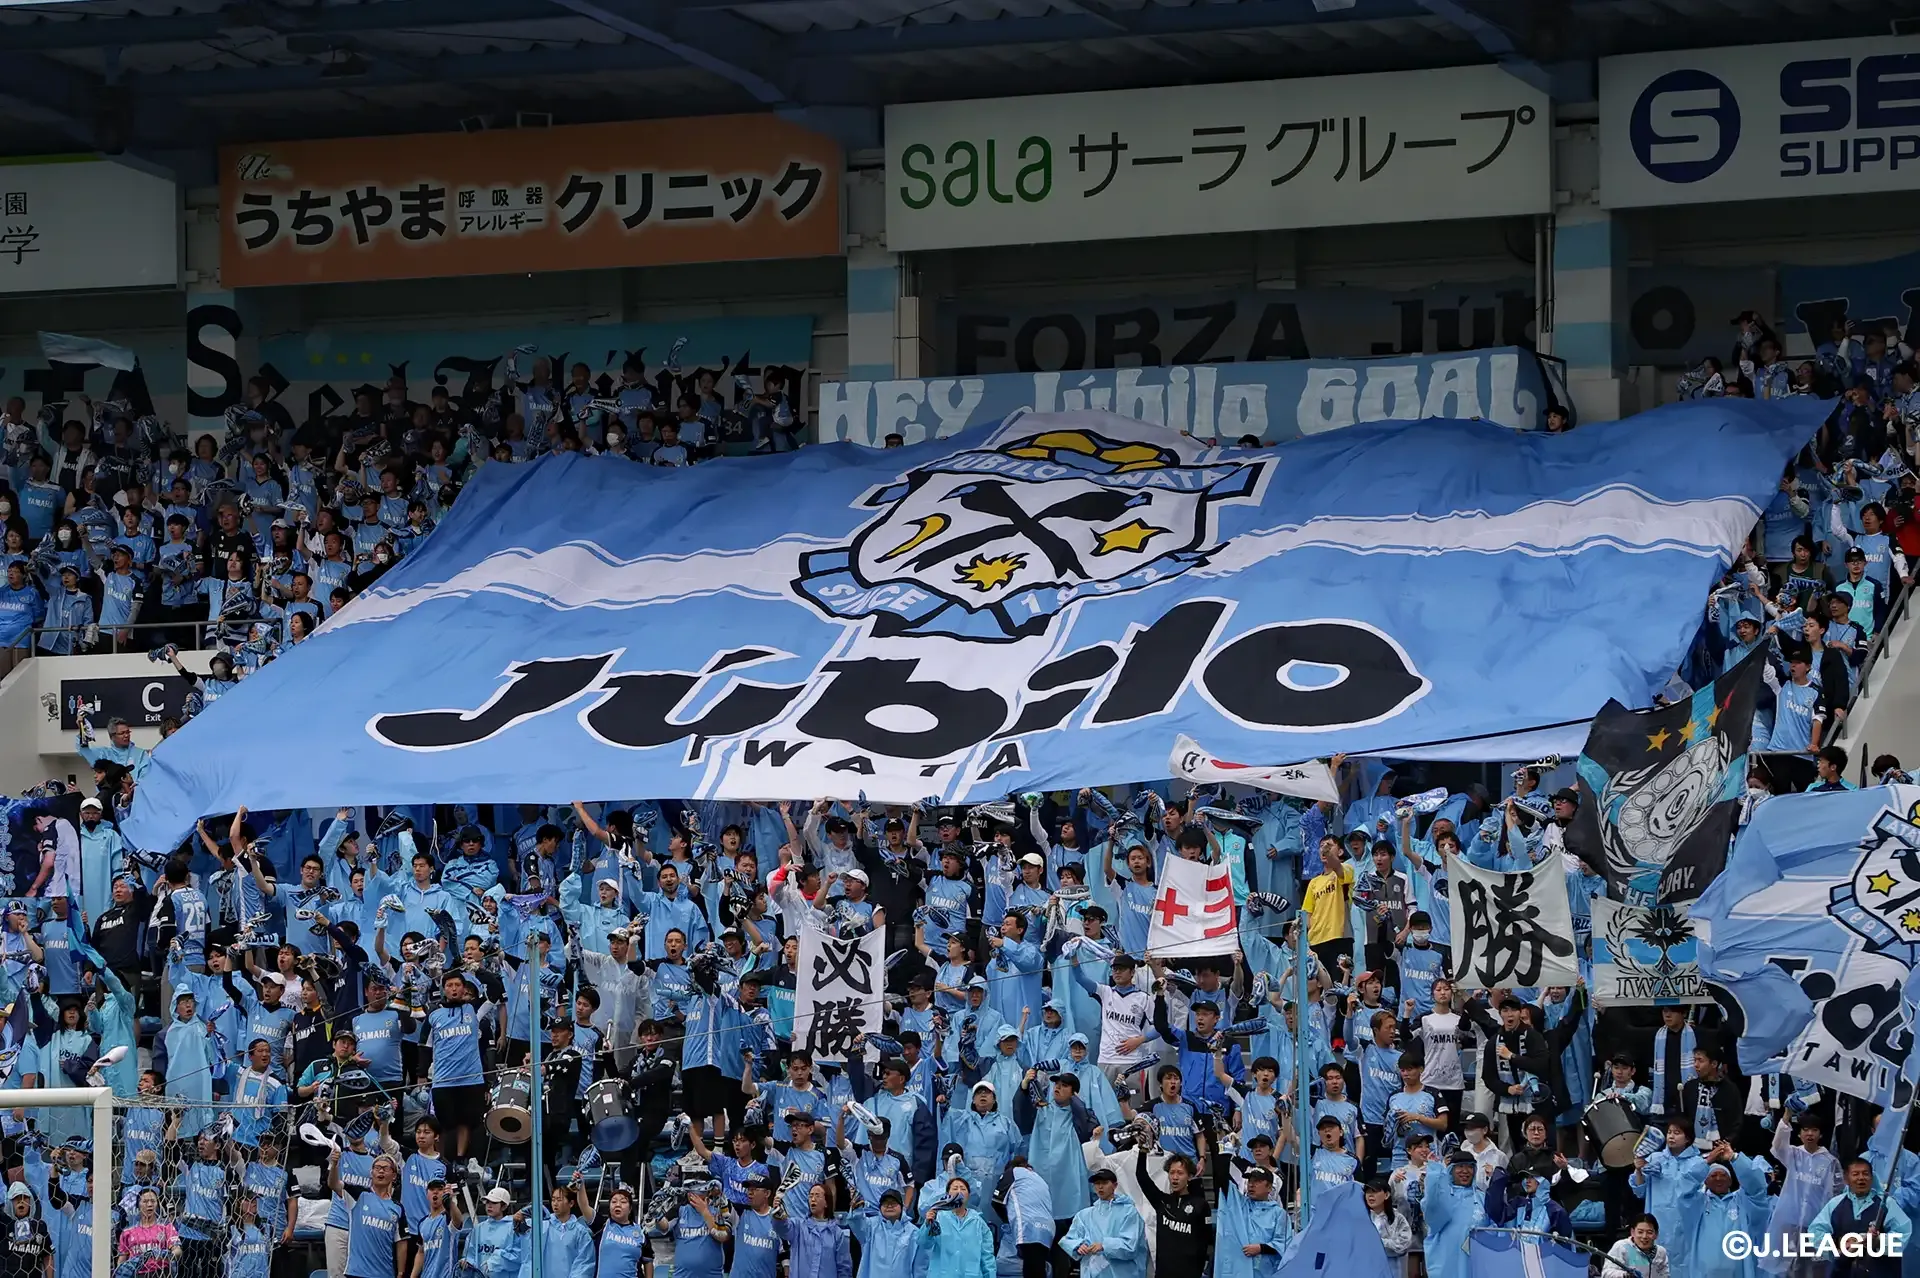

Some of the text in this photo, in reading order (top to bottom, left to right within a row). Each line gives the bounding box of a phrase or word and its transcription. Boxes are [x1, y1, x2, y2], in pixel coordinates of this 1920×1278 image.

[1069, 105, 1535, 198] サーラグループ
[555, 161, 822, 232] クリニック
[236, 184, 446, 249] うちやま
[459, 211, 543, 233] アレルギー
[957, 301, 1311, 374] FORZA
[819, 376, 985, 449] HEY
[1299, 352, 1537, 437] GOAL
[818, 582, 928, 614] SINCE
[370, 598, 1428, 758] Júbilo
[141, 682, 164, 712] C
[145, 714, 161, 722] Exit
[689, 735, 1024, 779] IWATA
[183, 903, 205, 932] 26
[1455, 872, 1574, 988] 勝
[1405, 969, 1434, 981] YAMAHA
[1616, 974, 1712, 998] IWATA
[776, 990, 796, 1001] YAMA
[808, 939, 872, 1059] 必勝
[1106, 1010, 1135, 1025] YAMAHA
[357, 1029, 391, 1042] YAMAHA
[439, 1026, 471, 1039] YAMAHA
[1160, 1126, 1191, 1137] YAMAHA
[362, 1216, 394, 1231] YAMAHA
[1163, 1216, 1191, 1234] YAMAHA
[743, 1234, 773, 1250] YAMAHA
